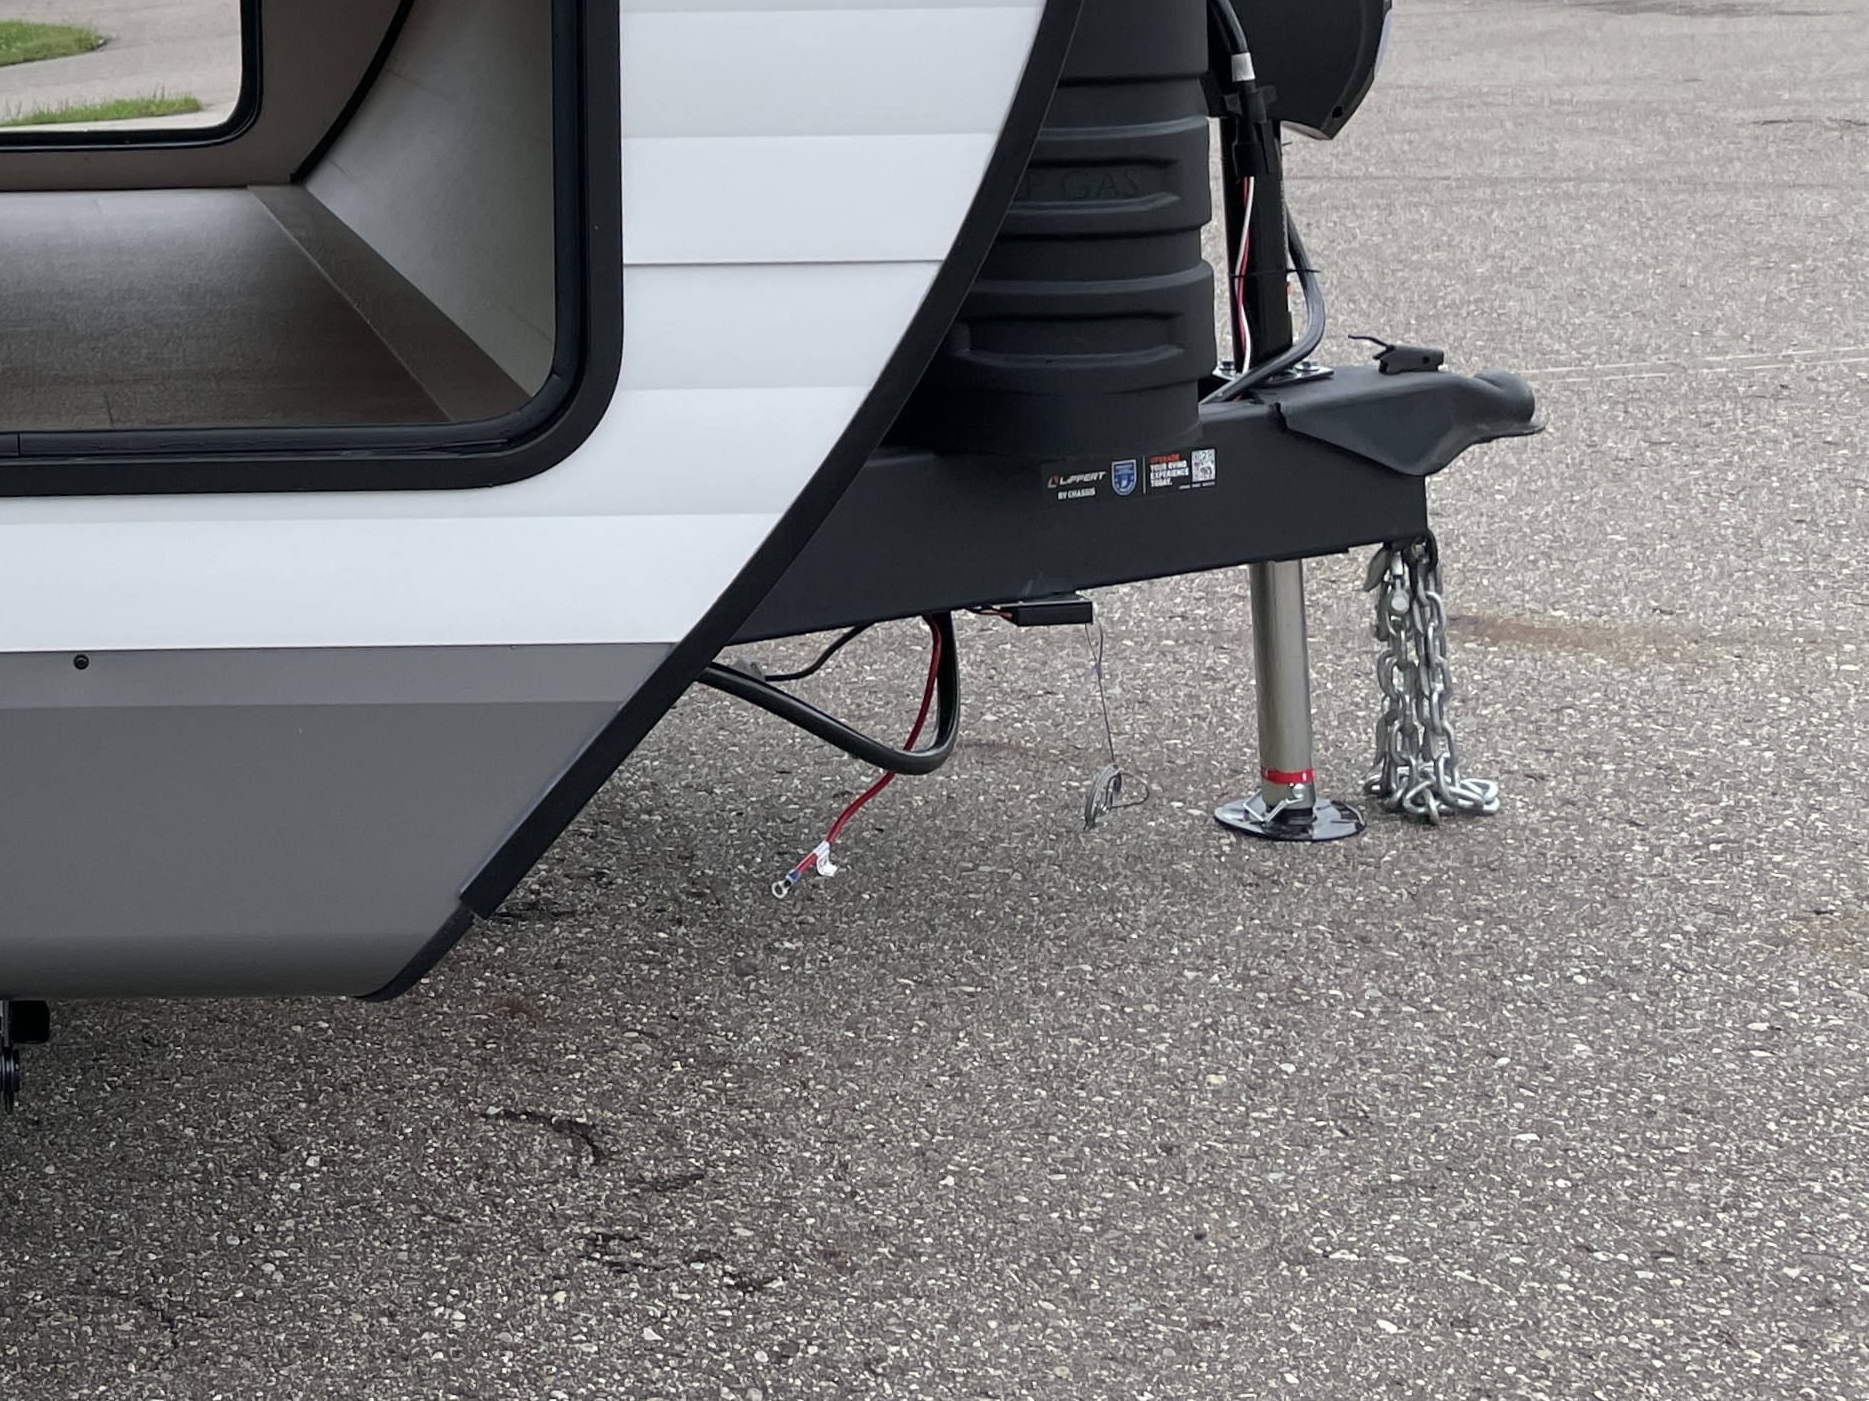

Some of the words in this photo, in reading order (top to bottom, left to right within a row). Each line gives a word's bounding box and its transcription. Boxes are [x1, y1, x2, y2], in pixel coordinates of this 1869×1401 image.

[1062, 168, 1140, 200] GAS
[1060, 471, 1107, 486] LIPPERT
[1150, 467, 1189, 479] EXPERIENCE
[1068, 487, 1096, 499] CHASSIS
